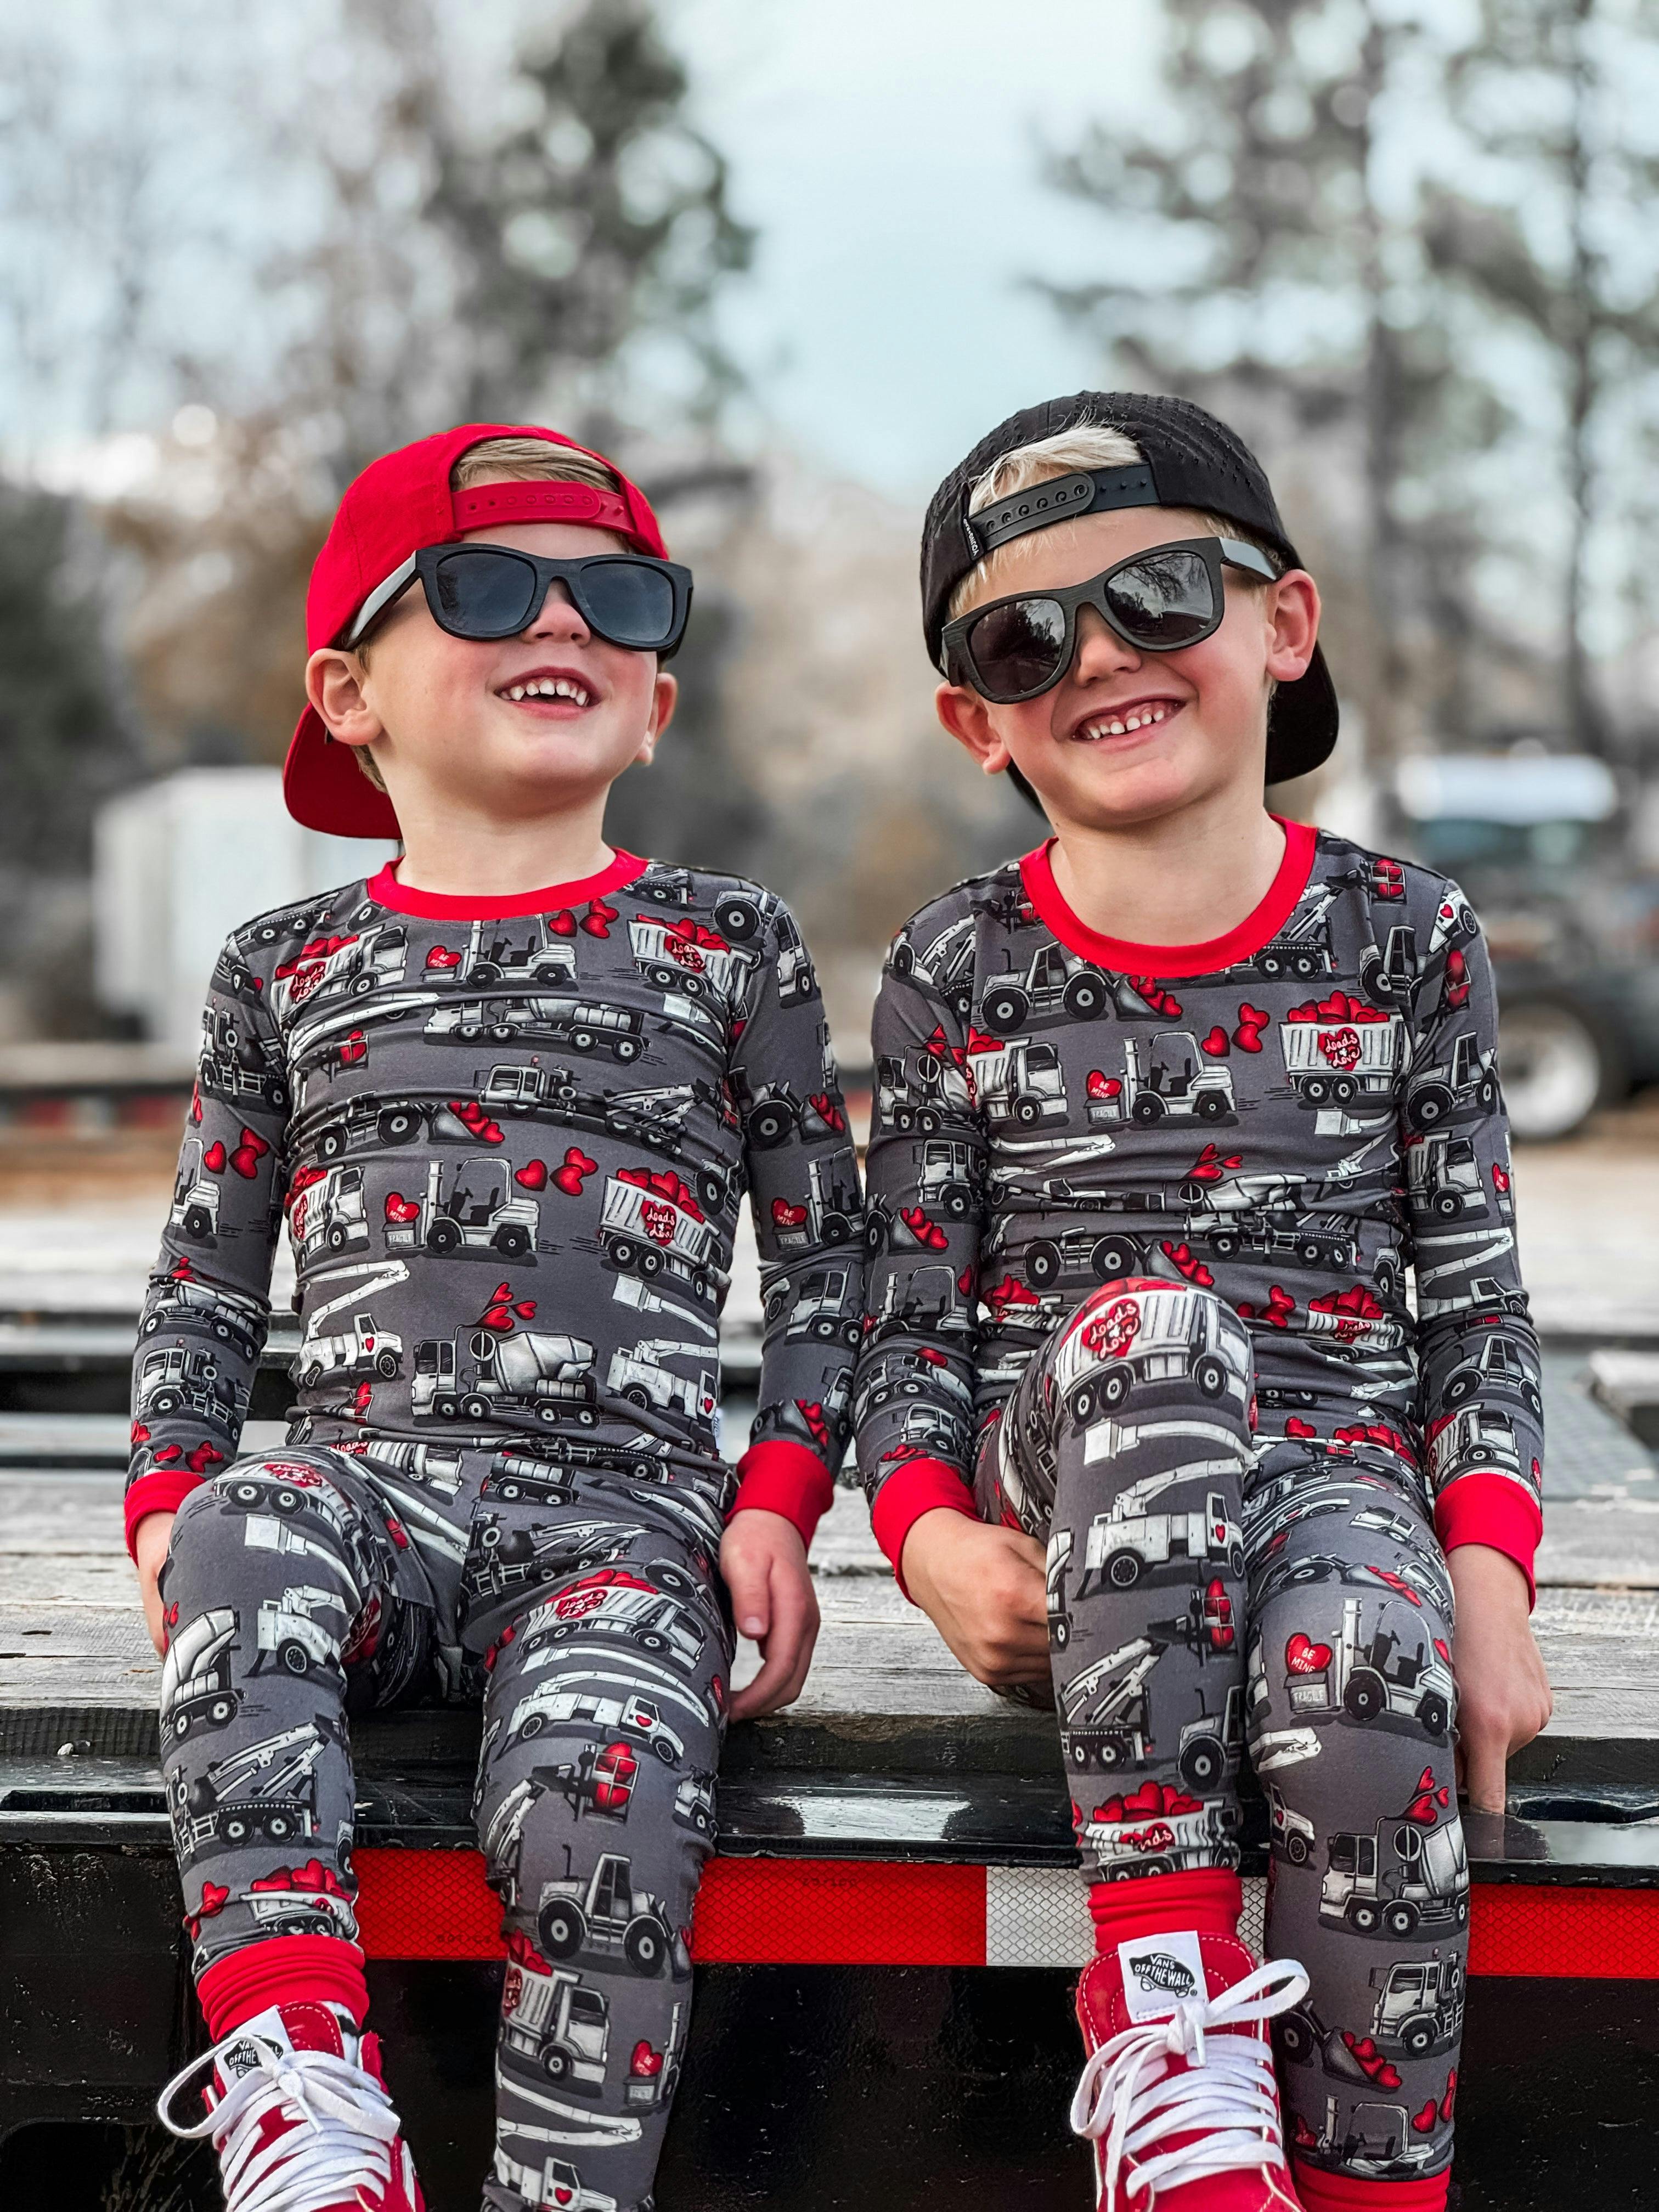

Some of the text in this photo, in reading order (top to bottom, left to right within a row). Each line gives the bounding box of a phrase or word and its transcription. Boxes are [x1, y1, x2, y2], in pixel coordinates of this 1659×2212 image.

[1325, 1034, 1358, 1053] Loads
[1333, 1047, 1360, 1067] Love
[1099, 1081, 1110, 1090] BE
[397, 1204, 408, 1214] BE
[647, 1207, 675, 1226] Loads
[783, 1209, 795, 1218] BE
[1090, 1303, 1137, 1345] Loads
[1099, 1317, 1139, 1359] Love
[1301, 1647, 1316, 1660] BE
[1150, 1954, 1176, 1970] VANS
[1134, 1963, 1190, 1987] OFF THE WALL
[229, 2052, 242, 2066] OFF
[241, 2049, 257, 2065] THE
